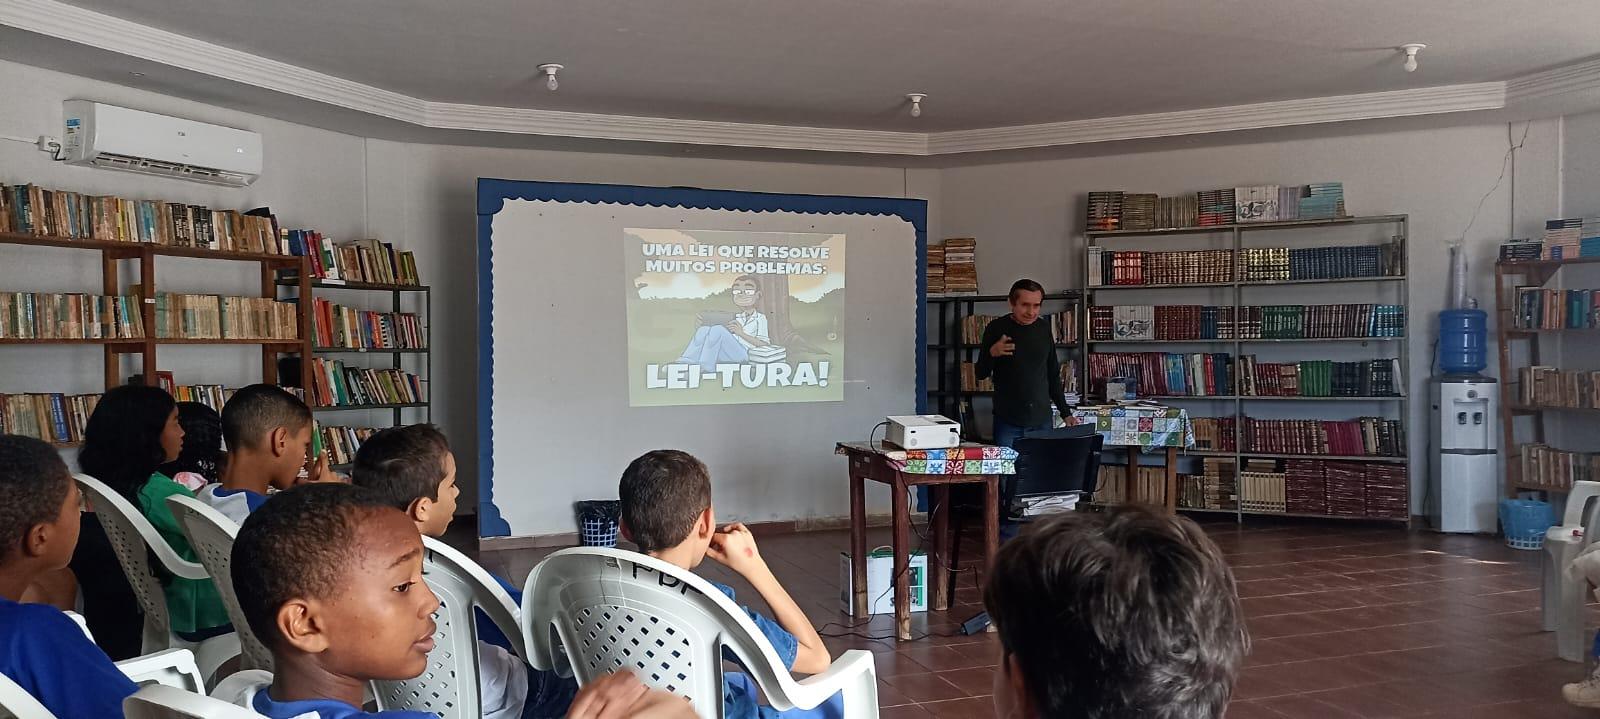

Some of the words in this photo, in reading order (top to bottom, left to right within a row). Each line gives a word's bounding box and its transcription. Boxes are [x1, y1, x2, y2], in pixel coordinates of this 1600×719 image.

[642, 243, 684, 257] UMA
[688, 244, 714, 257] LEI
[717, 245, 754, 258] QUE
[757, 246, 830, 260] RESOLVE
[645, 259, 716, 273] MUITOS
[719, 261, 828, 275] PROBLEMAS:
[646, 361, 829, 389] LEI-TURA!
